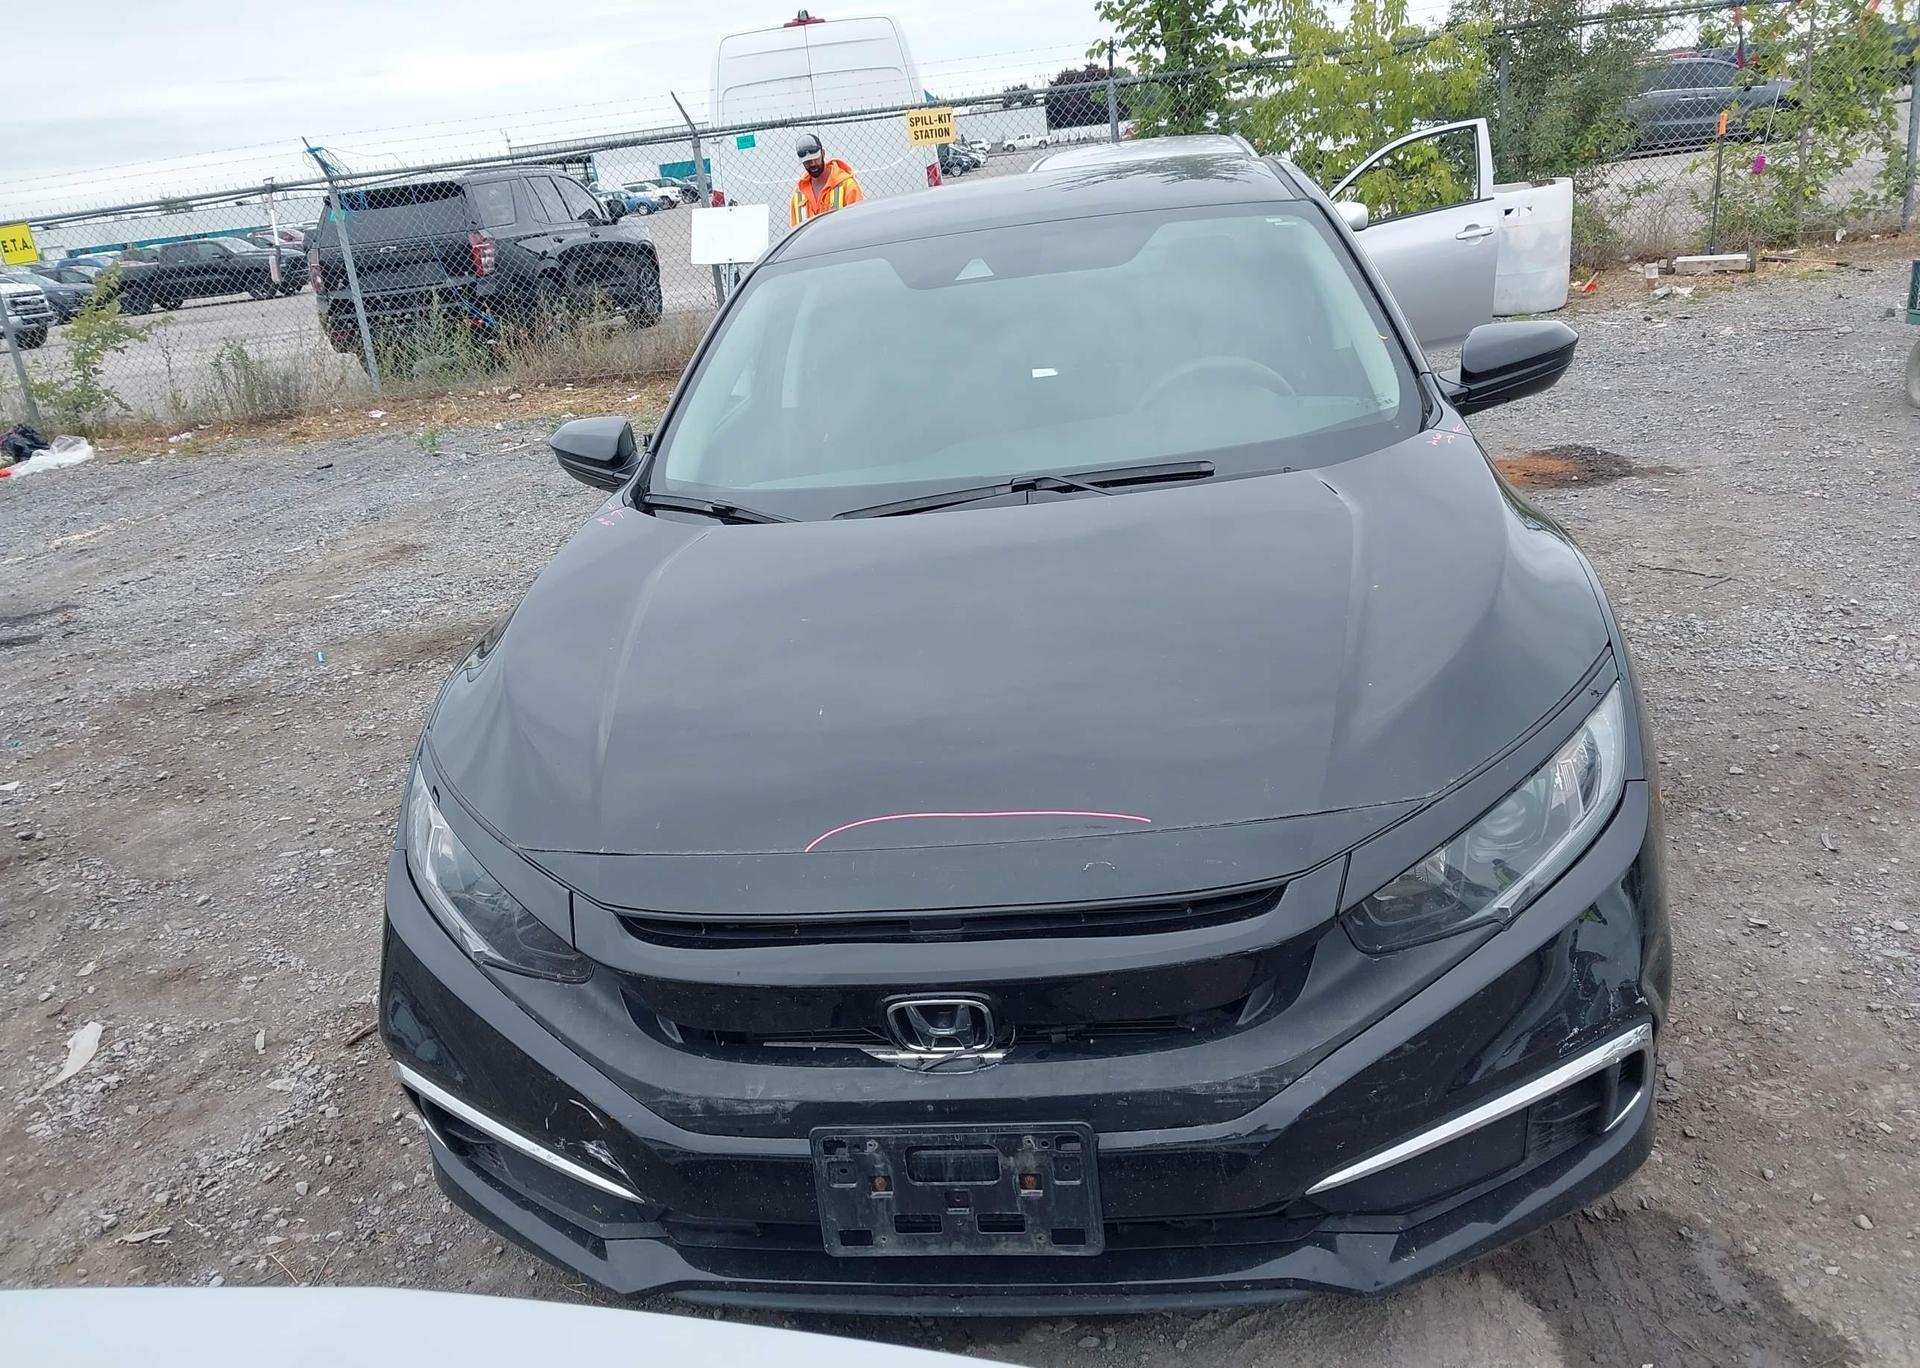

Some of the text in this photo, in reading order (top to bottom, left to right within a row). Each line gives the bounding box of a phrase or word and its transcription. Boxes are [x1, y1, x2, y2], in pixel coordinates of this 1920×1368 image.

[909, 113, 952, 127] SPILL-KIT
[913, 127, 950, 140] STATION
[1, 238, 32, 253] E.T.A.
